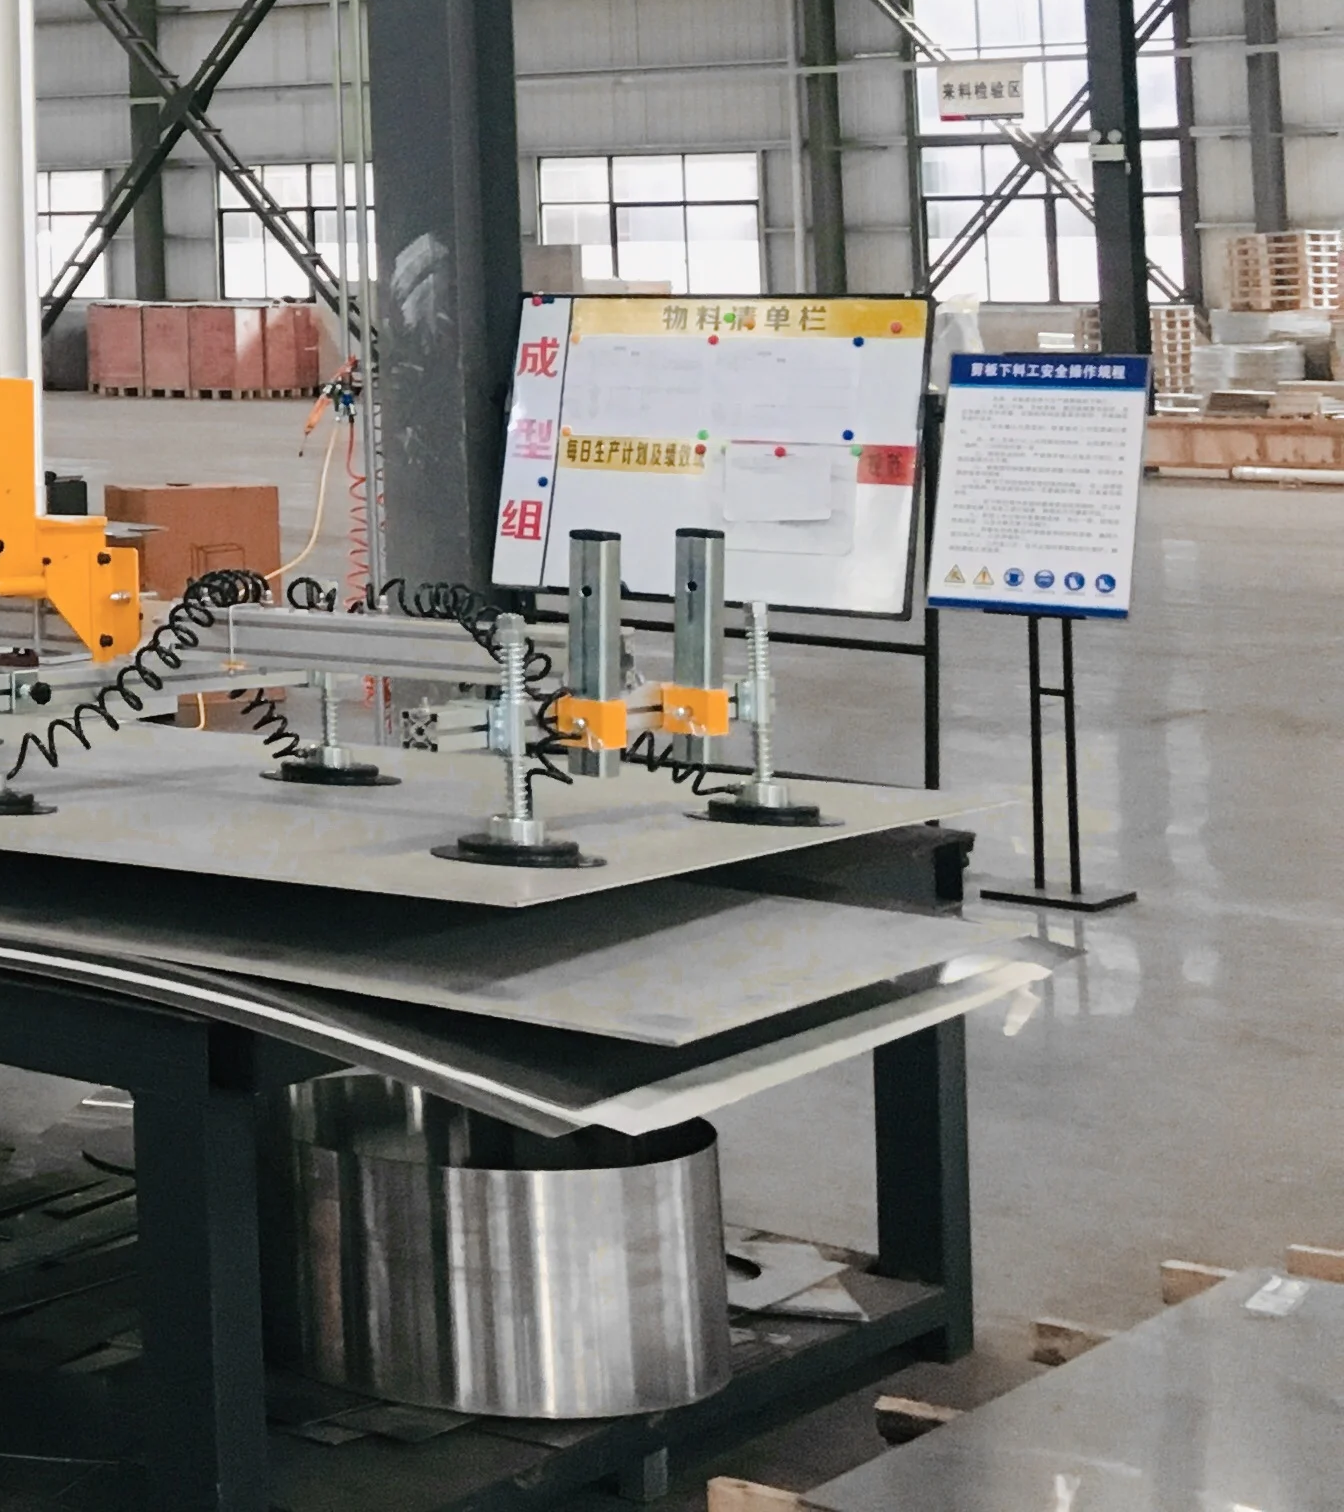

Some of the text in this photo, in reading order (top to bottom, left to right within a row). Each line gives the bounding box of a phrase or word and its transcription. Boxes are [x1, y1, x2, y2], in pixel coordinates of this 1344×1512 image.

[942, 79, 1021, 101] 来料检验区
[662, 304, 827, 332] 物料清单栏
